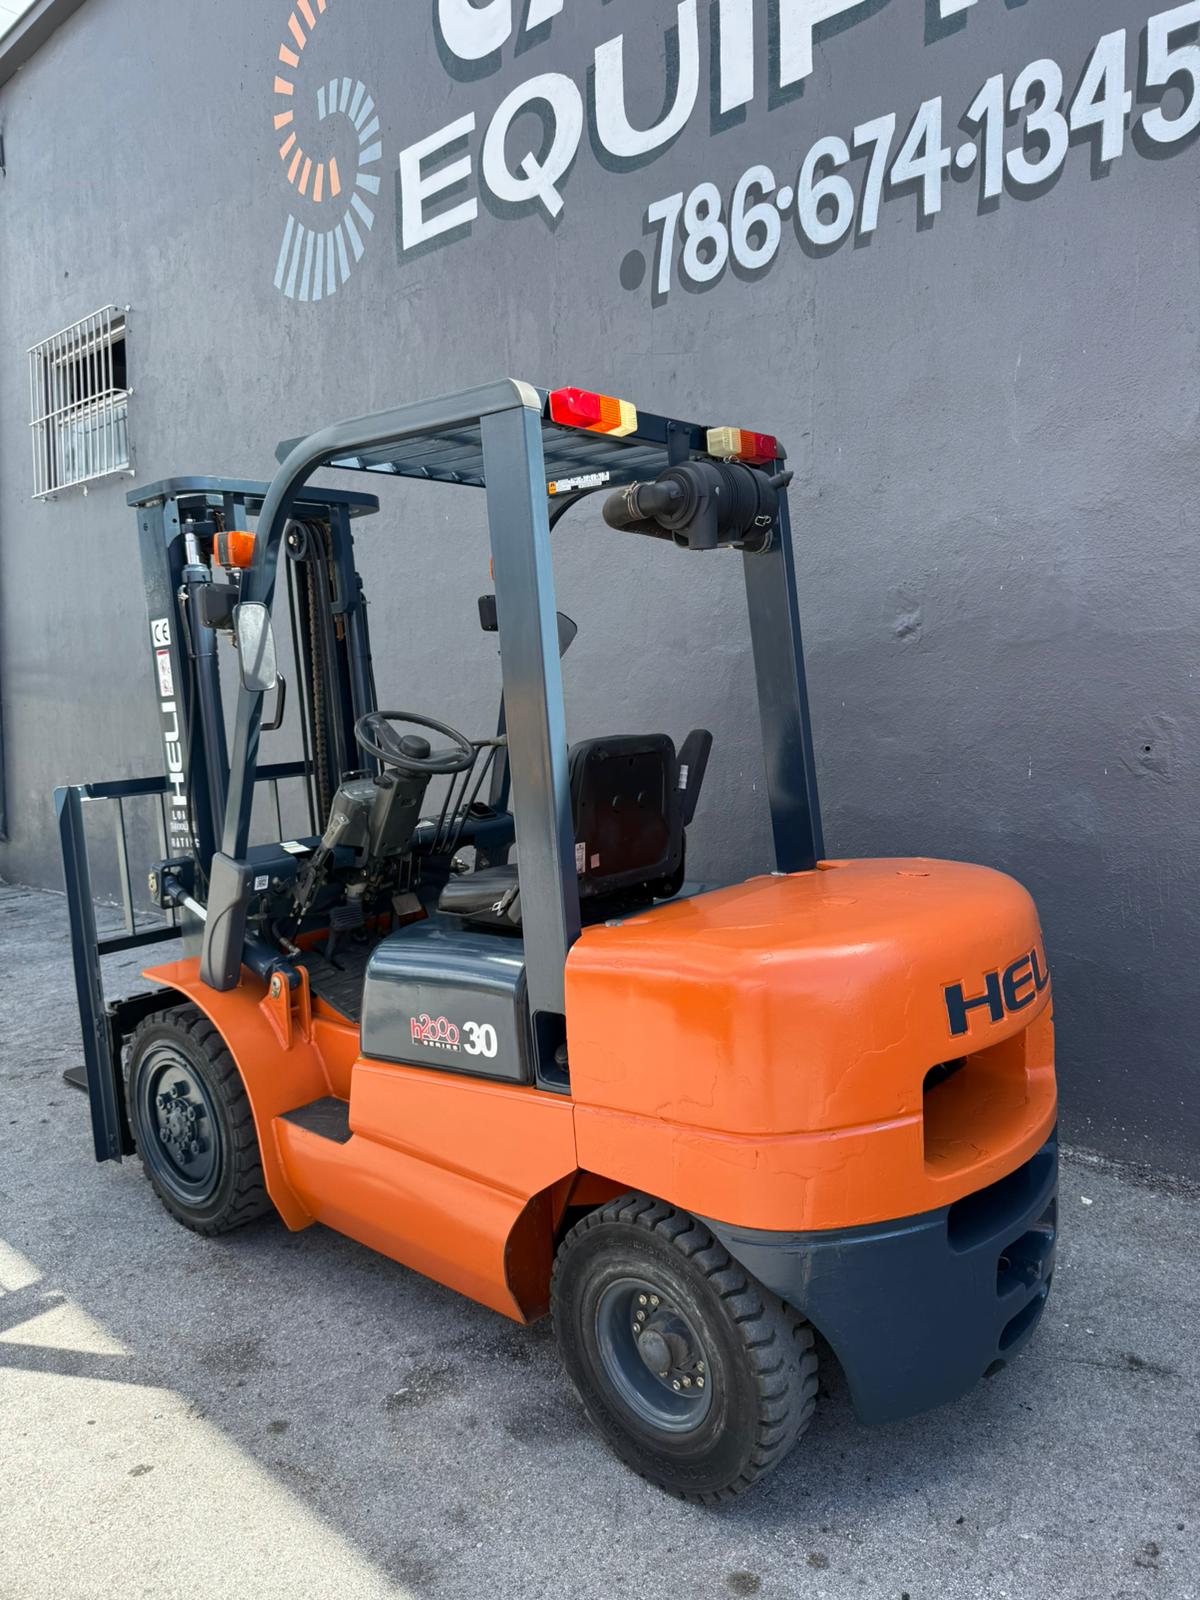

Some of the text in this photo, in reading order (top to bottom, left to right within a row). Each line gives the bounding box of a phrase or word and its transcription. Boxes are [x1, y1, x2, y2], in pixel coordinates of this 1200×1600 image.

[154, 622, 170, 642] CE
[161, 701, 188, 806] HELI
[944, 949, 1050, 1036] HEL
[462, 1021, 498, 1058] 30
